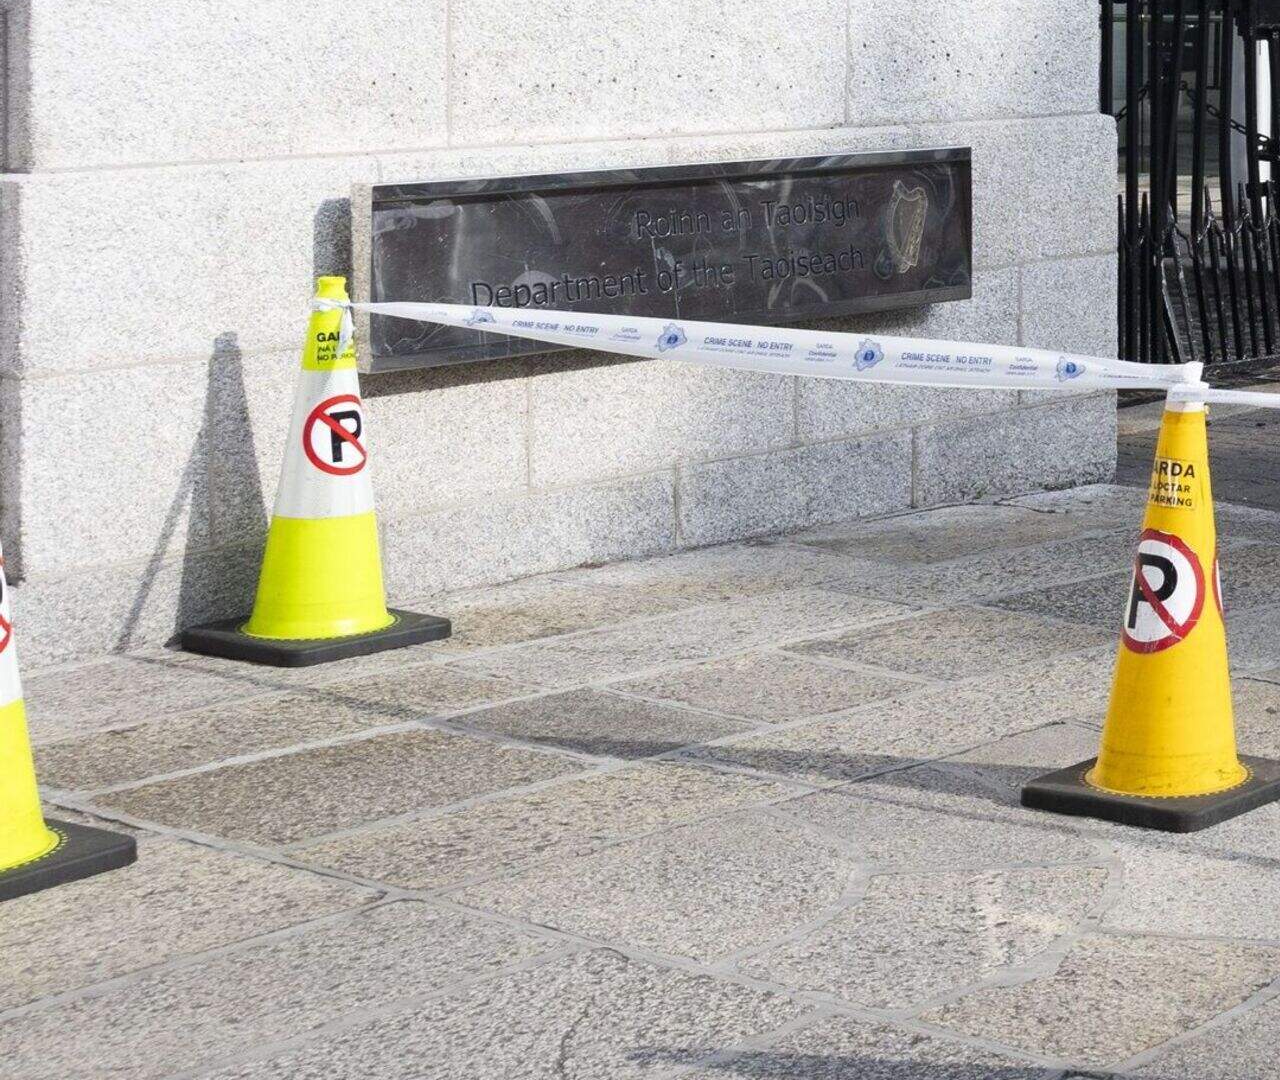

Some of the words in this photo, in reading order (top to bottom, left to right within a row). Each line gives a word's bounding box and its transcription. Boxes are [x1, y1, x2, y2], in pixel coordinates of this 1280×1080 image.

[636, 208, 711, 239] Roinn
[721, 208, 752, 231] an
[760, 193, 861, 228] Taoisigh
[471, 267, 648, 308] Department
[656, 259, 686, 294] of
[691, 255, 736, 289] the
[743, 242, 865, 282] Taoiseach
[576, 325, 599, 334] ENTRY
[704, 337, 727, 346] CRIME
[728, 338, 752, 348] SCENE
[757, 341, 769, 349] NO
[770, 342, 793, 351] ENTRY
[901, 352, 924, 361] CRIME
[926, 353, 950, 363] SCENE
[956, 356, 967, 364] NO
[968, 356, 992, 365] ENTRY
[330, 409, 361, 462] P
[1128, 553, 1178, 629] P
